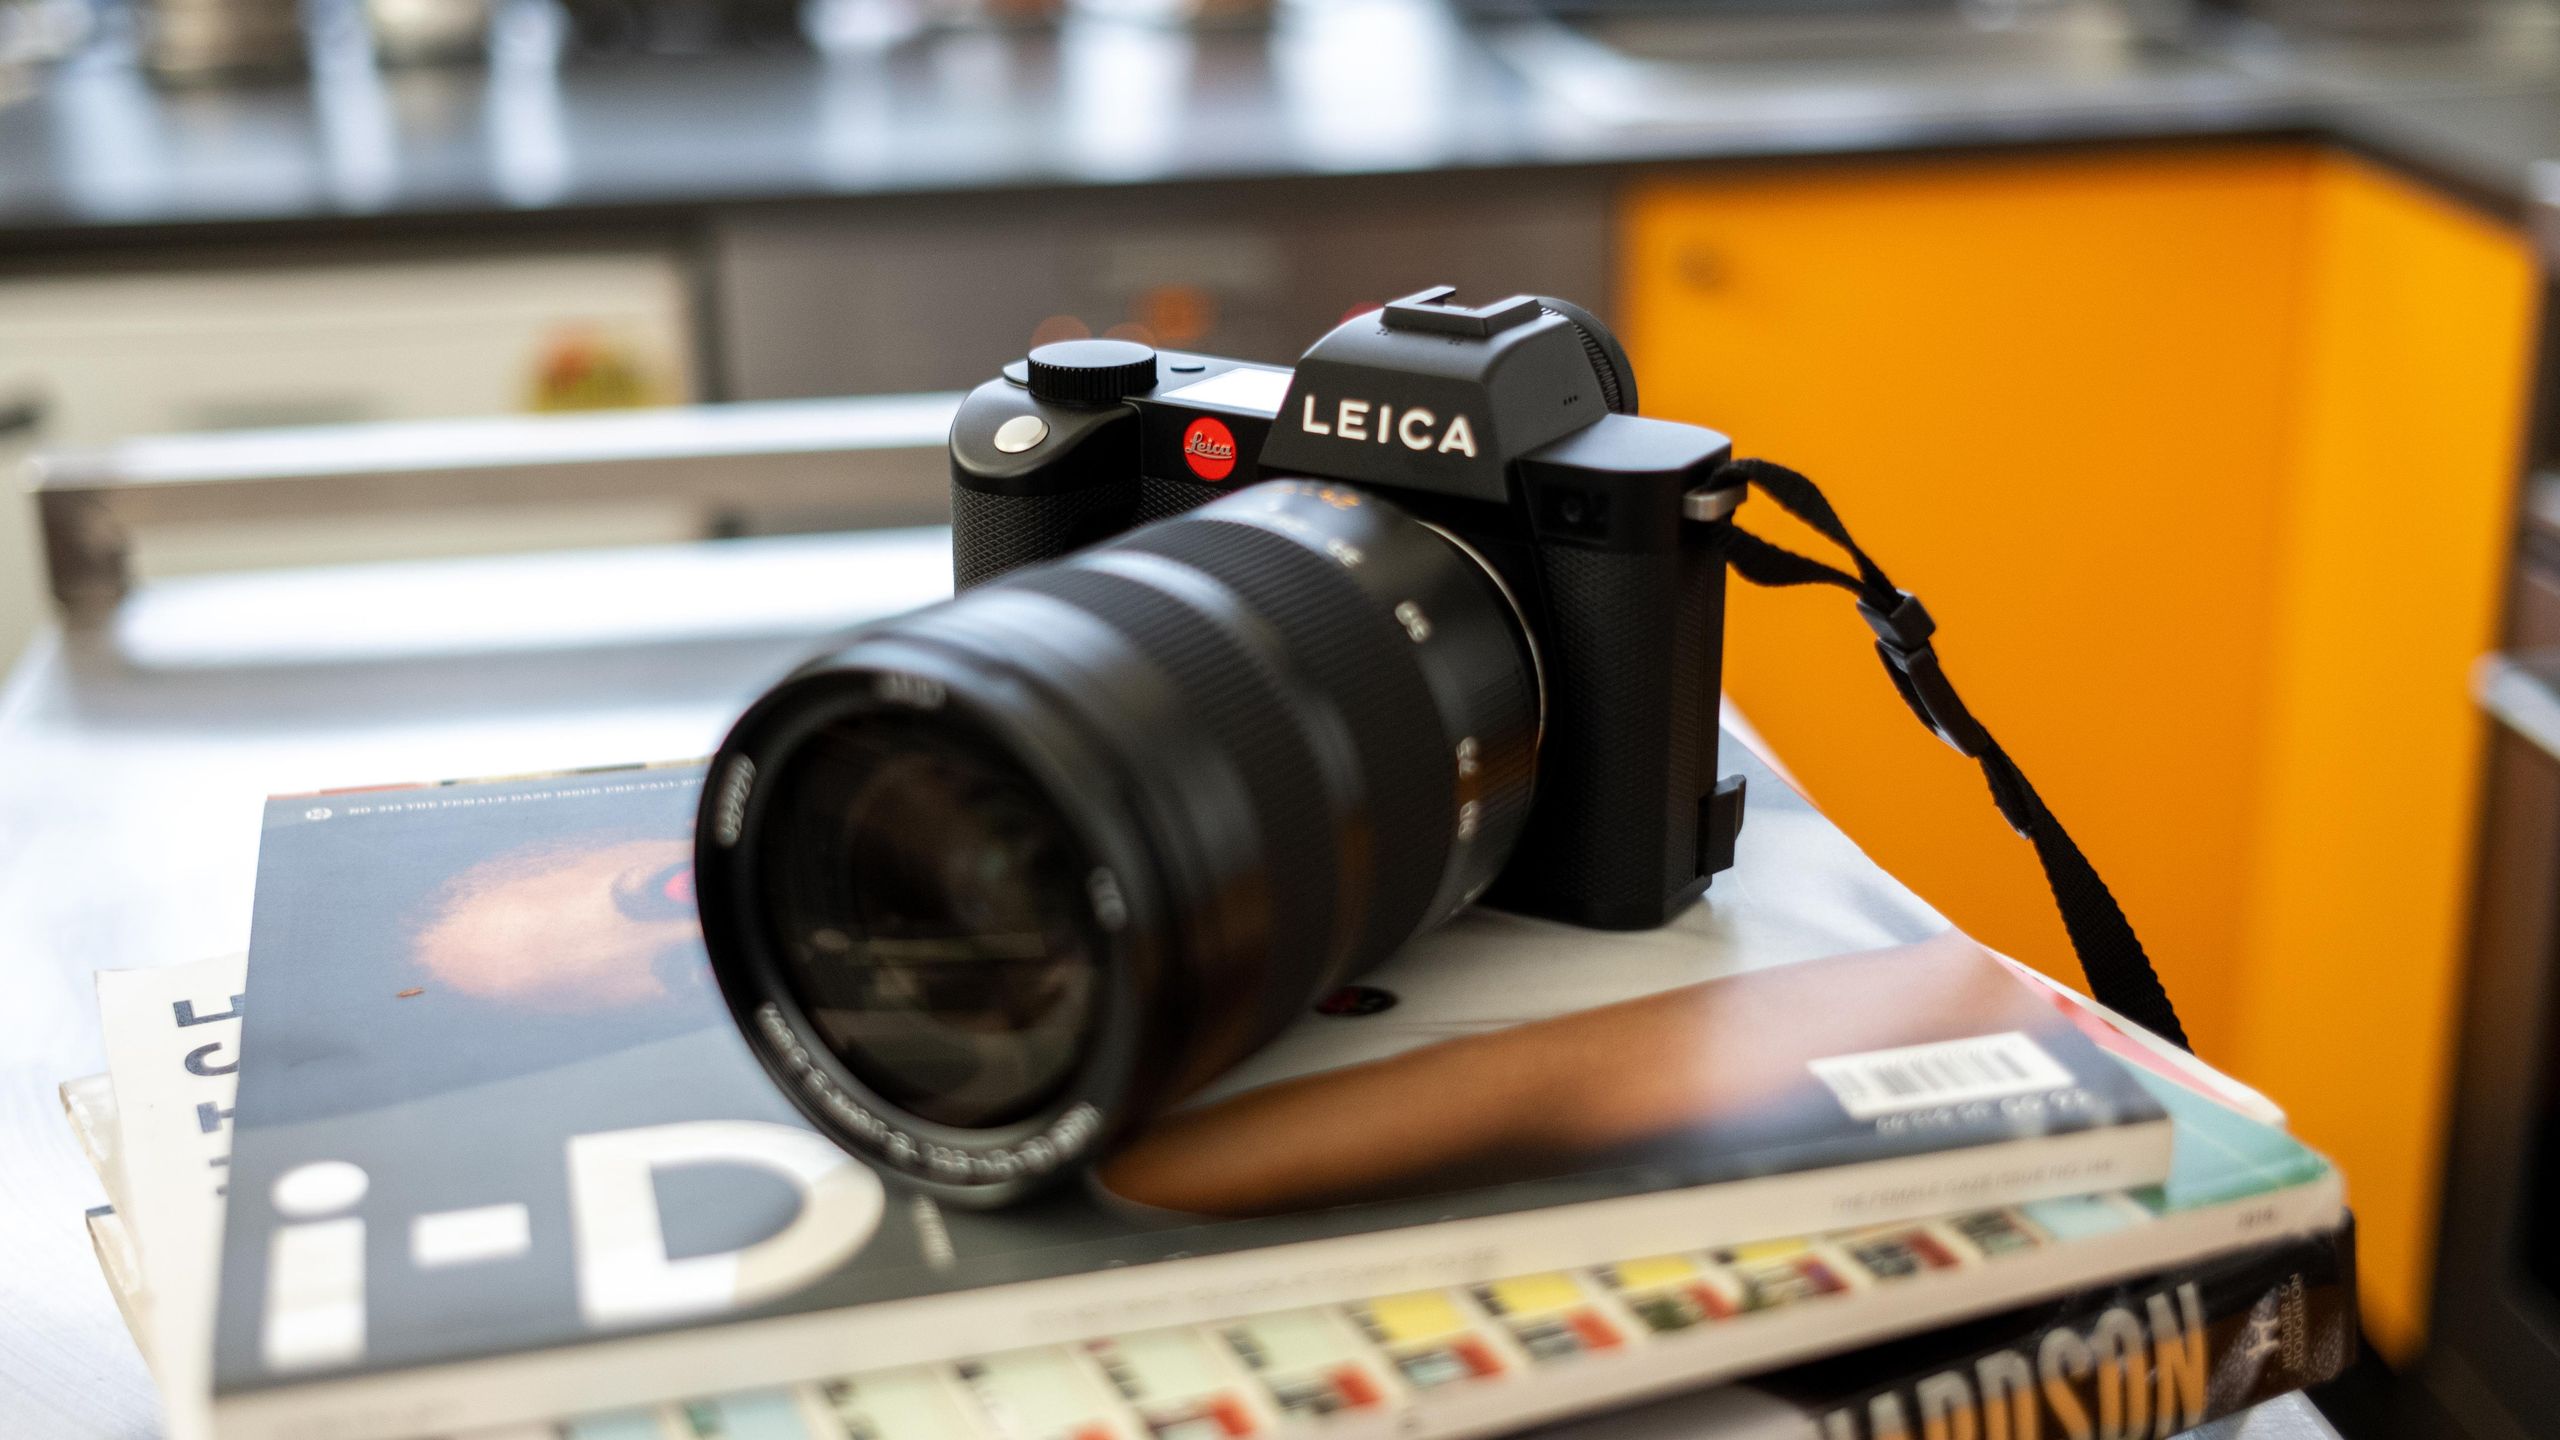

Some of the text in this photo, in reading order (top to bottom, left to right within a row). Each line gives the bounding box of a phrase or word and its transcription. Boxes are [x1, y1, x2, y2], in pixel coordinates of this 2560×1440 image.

[1184, 431, 1233, 460] Leica
[1302, 394, 1477, 458] LEICA
[262, 1119, 886, 1372] i-D
[2280, 1298, 2294, 1370] HODDER
[2290, 1272, 2305, 1370] STOUGHTON
